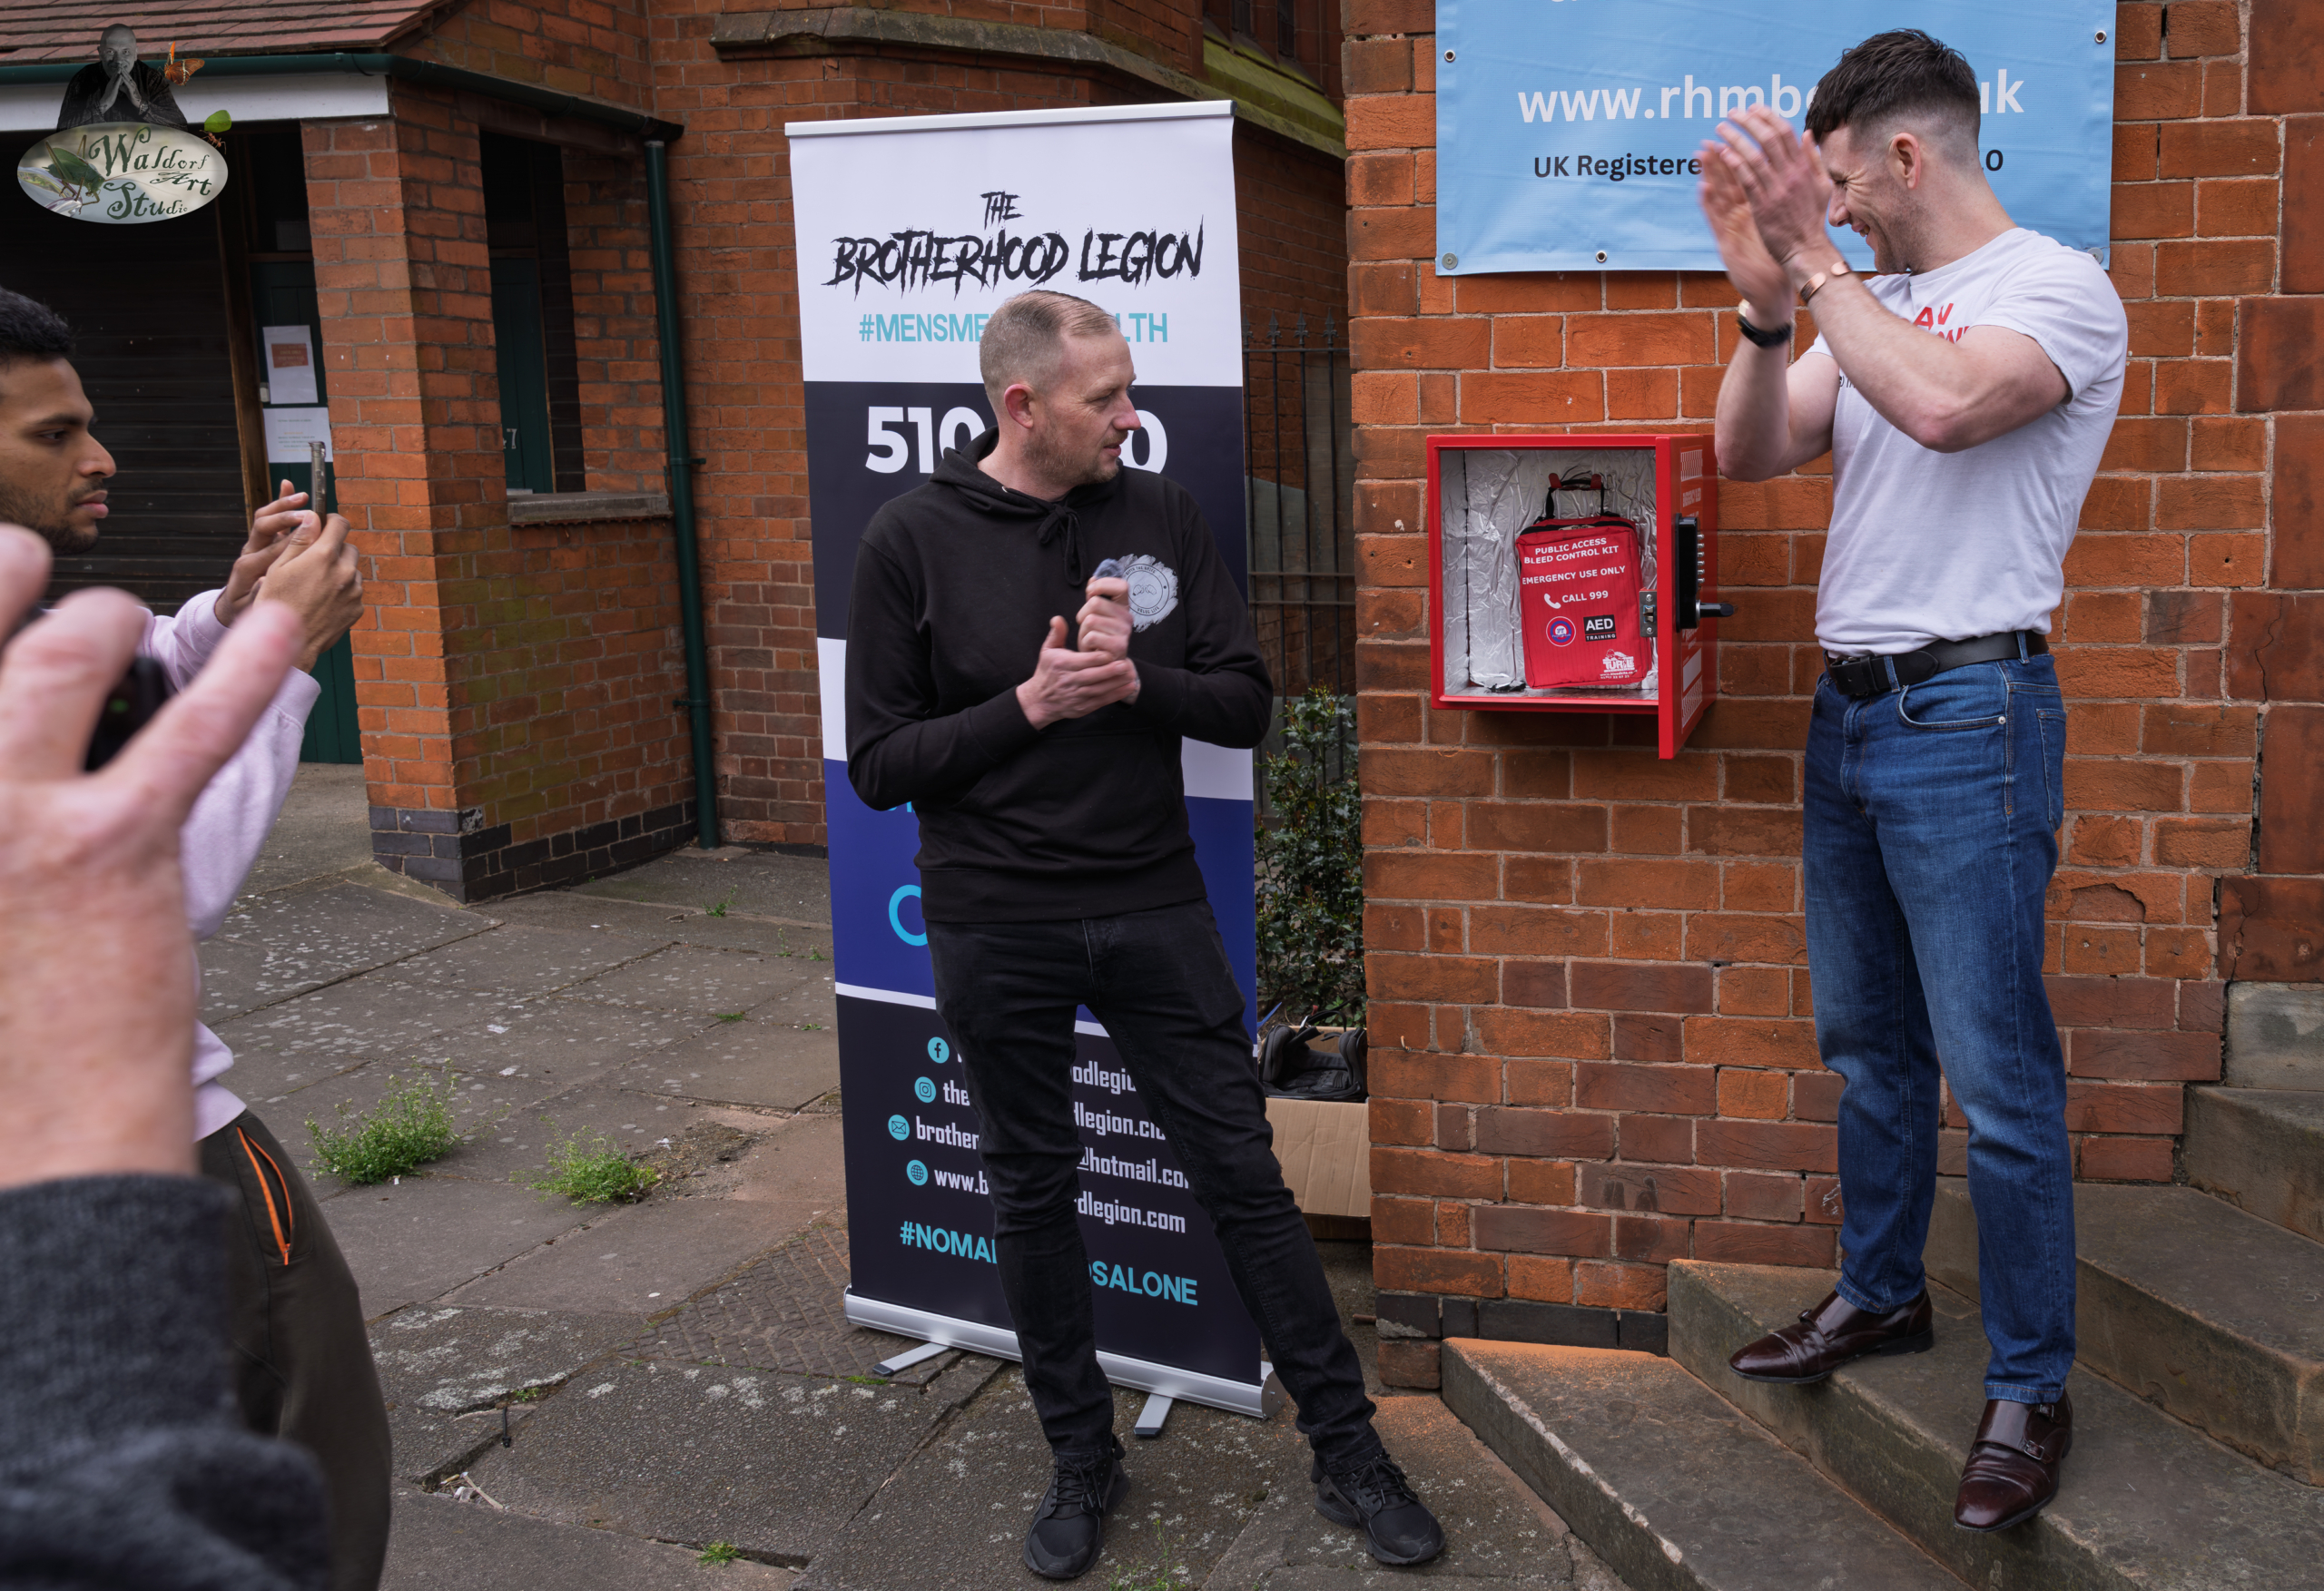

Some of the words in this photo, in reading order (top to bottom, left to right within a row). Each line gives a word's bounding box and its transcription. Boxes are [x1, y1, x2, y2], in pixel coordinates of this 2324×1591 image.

[1534, 156, 1570, 178] UK
[1577, 152, 1703, 182] Registere
[980, 190, 1025, 230] THE
[822, 225, 1070, 300] BROTHERHOOD
[1077, 214, 1205, 290] LEGION
[1524, 555, 1553, 564] BLEED
[1556, 548, 1600, 561] CONTROL
[1602, 545, 1619, 555] KIT
[1535, 544, 1570, 555] PUBLIC
[1571, 537, 1607, 550] ACCESS
[1521, 572, 1576, 584] EMERGENCY
[1579, 569, 1598, 578] USE
[1600, 565, 1626, 575] ONLY
[1561, 594, 1587, 603] CALL
[1590, 590, 1609, 600] 999
[1585, 618, 1613, 631] AED
